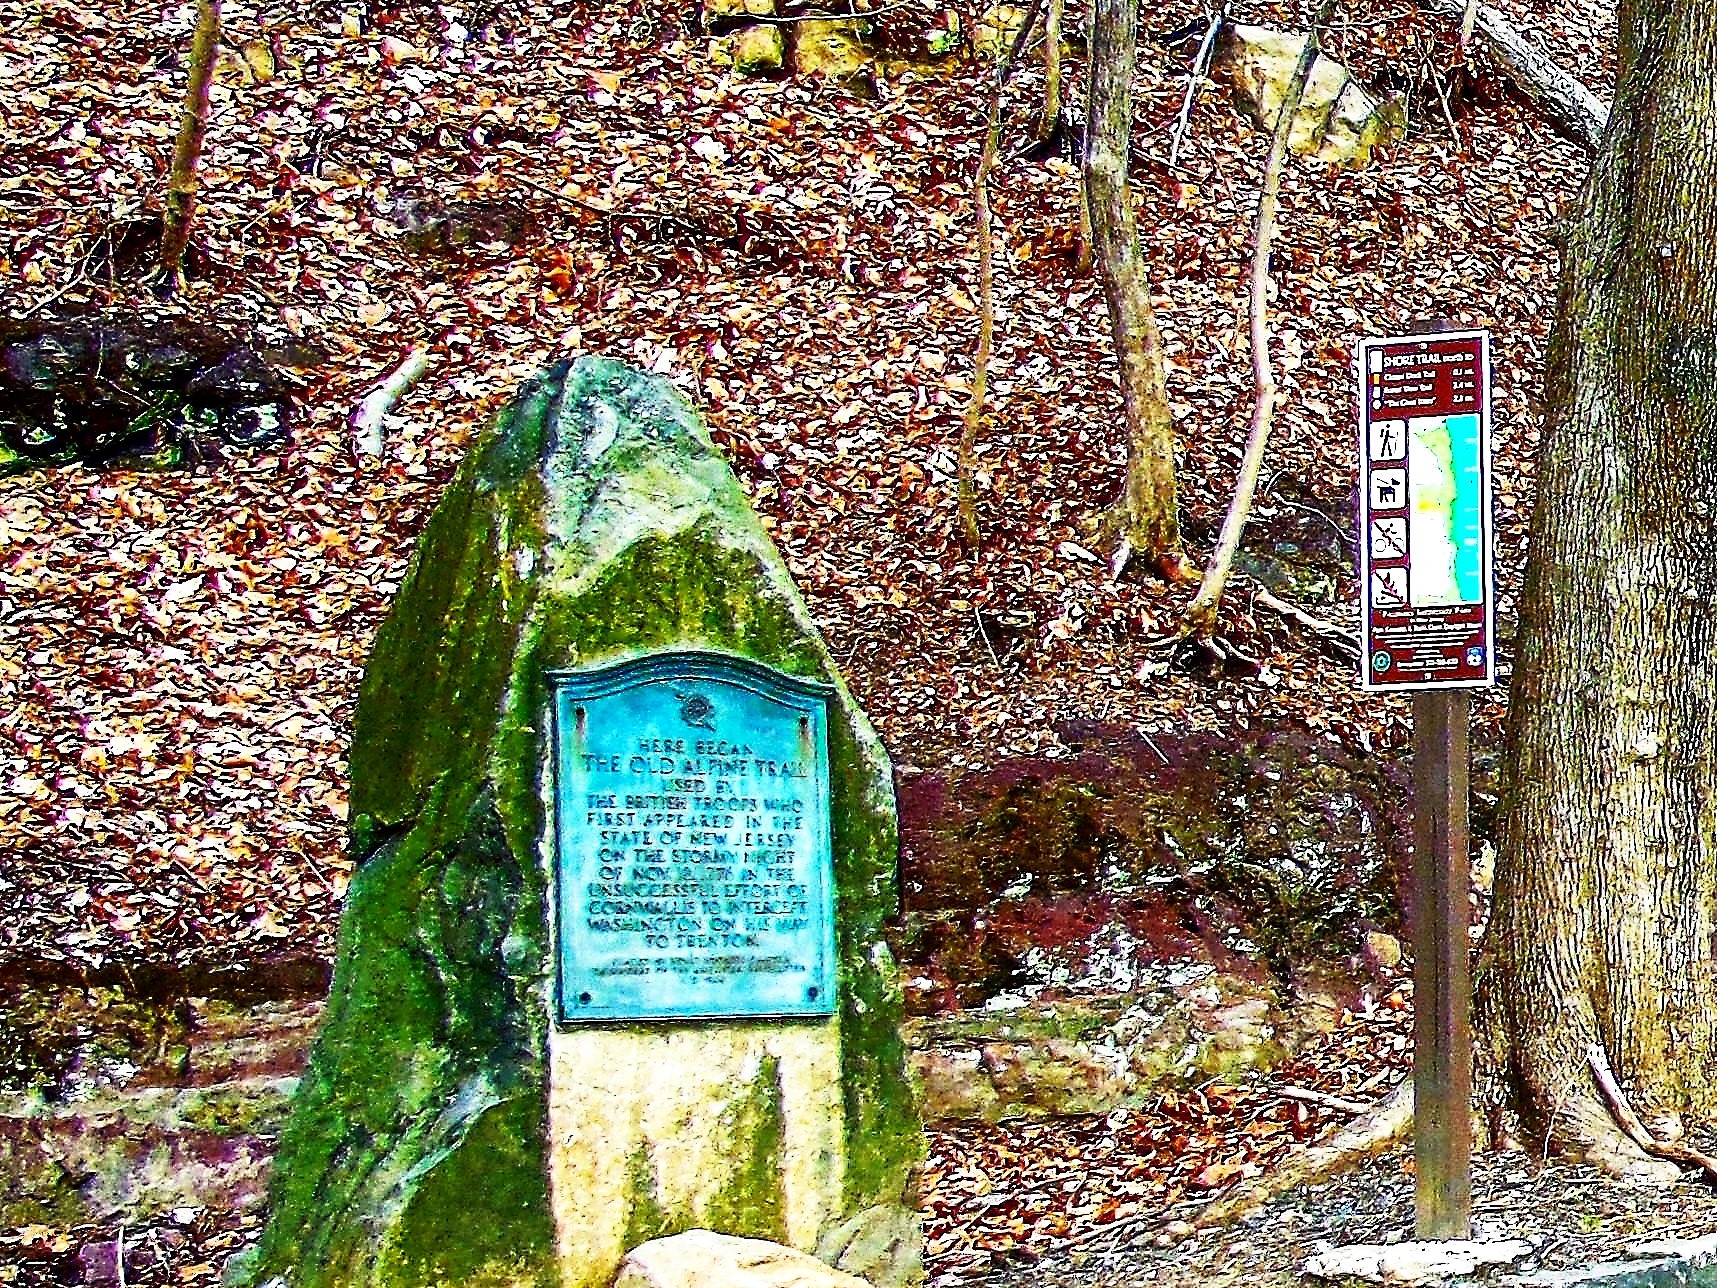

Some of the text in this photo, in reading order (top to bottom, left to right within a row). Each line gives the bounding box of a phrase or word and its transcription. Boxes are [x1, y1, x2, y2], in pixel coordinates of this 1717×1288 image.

[1416, 353, 1441, 365] TRAIL
[640, 739, 753, 756] HERE BEGAN
[581, 754, 807, 778] THE OLD ALPINE TRAIL
[587, 795, 803, 813] THE BRITISH TROOPS WHO
[587, 812, 803, 830] FIRST APPEARED IN THE
[599, 830, 796, 847] STATE OF NEW JERSEY
[598, 848, 795, 865] ON THE STORMY NIGHT
[599, 866, 623, 880] OF
[766, 868, 795, 882] THE
[587, 883, 807, 899] UNSUCCESSFUL EFFORT OF
[702, 901, 720, 915] TO
[587, 918, 702, 932] WASHINGTON
[711, 917, 735, 932] ON
[646, 934, 669, 949] TO
